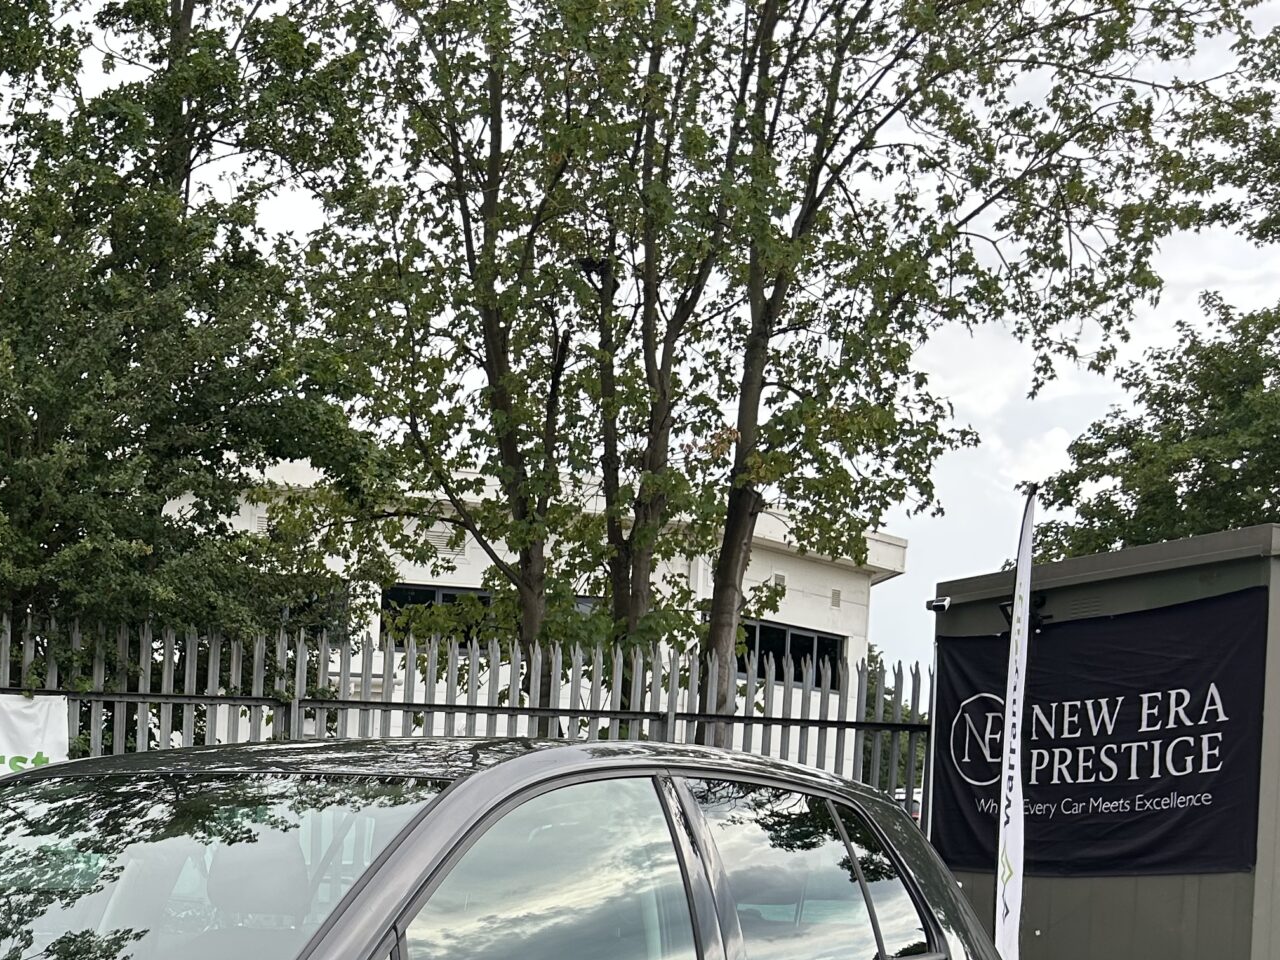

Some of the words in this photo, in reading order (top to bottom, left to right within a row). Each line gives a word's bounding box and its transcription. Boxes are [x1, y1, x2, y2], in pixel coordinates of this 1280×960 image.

[1030, 696, 1125, 740] NEW
[1138, 682, 1229, 732] ERA
[1029, 732, 1224, 786] PRESTIGE
[1023, 798, 1057, 819] Every
[1061, 798, 1085, 814] Car
[1089, 797, 1130, 814] Meets
[1135, 792, 1212, 812] Excellence
